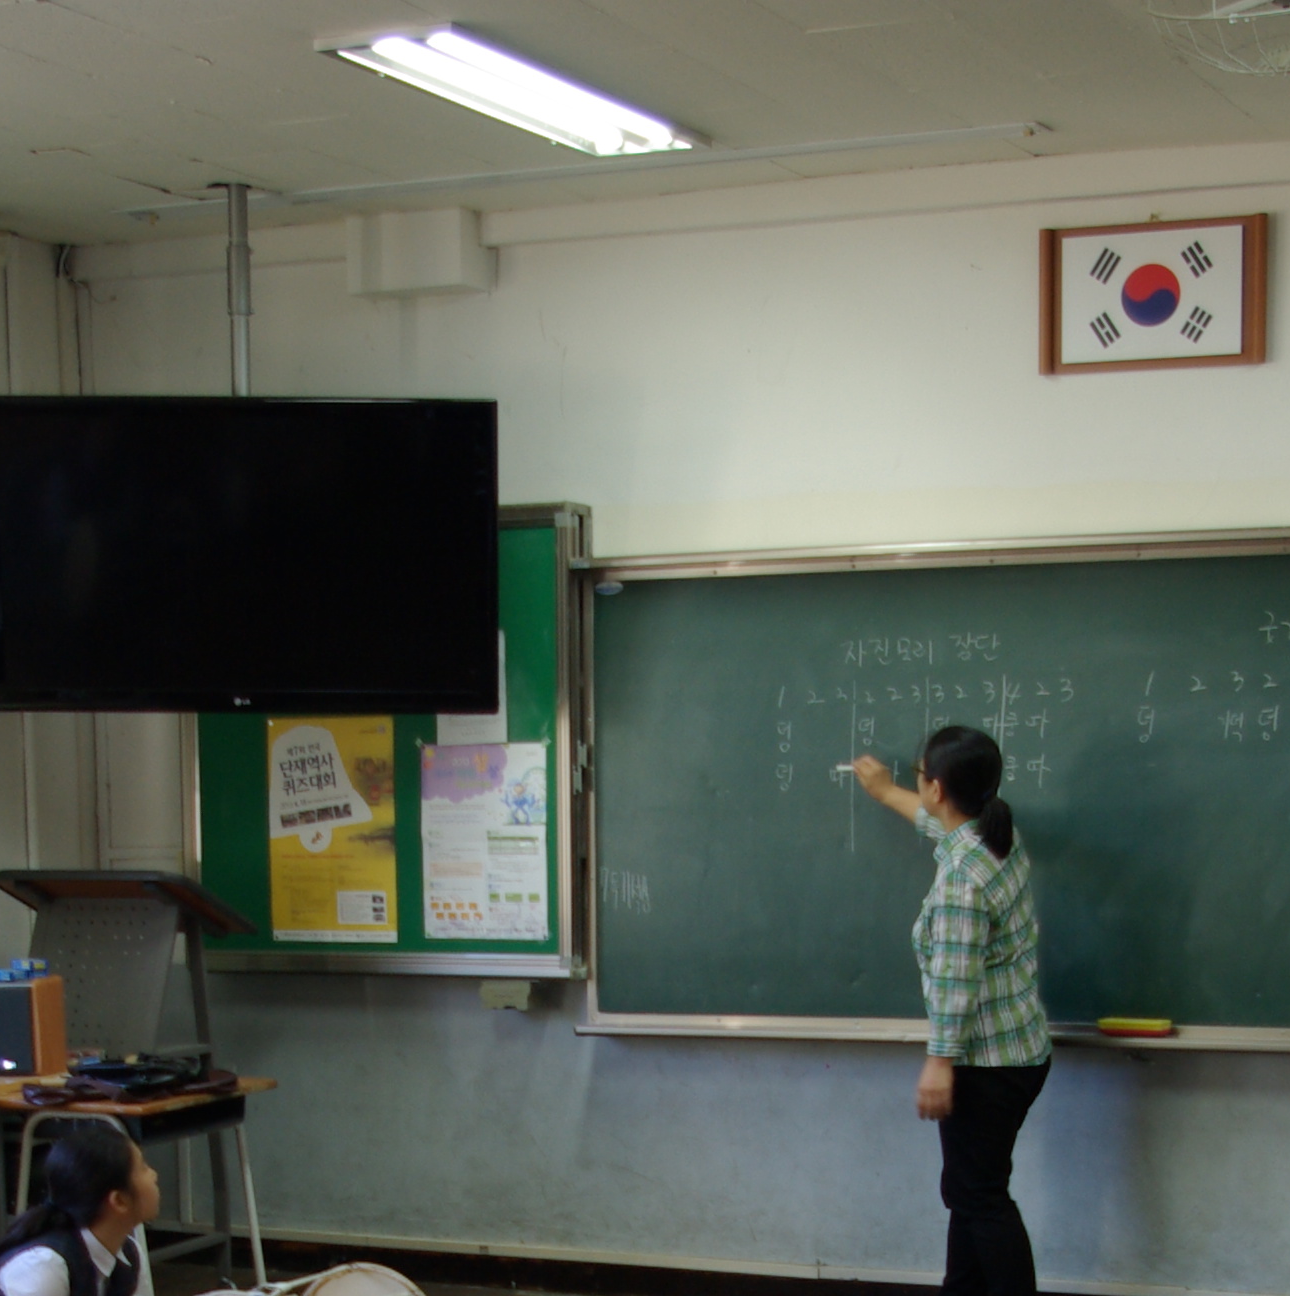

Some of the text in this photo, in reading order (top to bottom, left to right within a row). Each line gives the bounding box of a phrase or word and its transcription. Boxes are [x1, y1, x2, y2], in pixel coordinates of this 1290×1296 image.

[839, 631, 1002, 668] 자진모리 장단
[806, 690, 826, 704] 2
[885, 687, 904, 702] 2
[909, 684, 923, 704] 3
[931, 683, 946, 704] 3
[954, 685, 969, 700] 2
[981, 680, 996, 705] 3
[1005, 682, 1022, 706] 4
[1035, 681, 1052, 697] 2
[1059, 677, 1075, 704] 3
[1189, 674, 1207, 692] 2
[1231, 670, 1245, 693] 3
[1262, 672, 1278, 689] 2
[279, 752, 334, 779] 단재역사
[282, 770, 337, 797] 퀴즈대회
